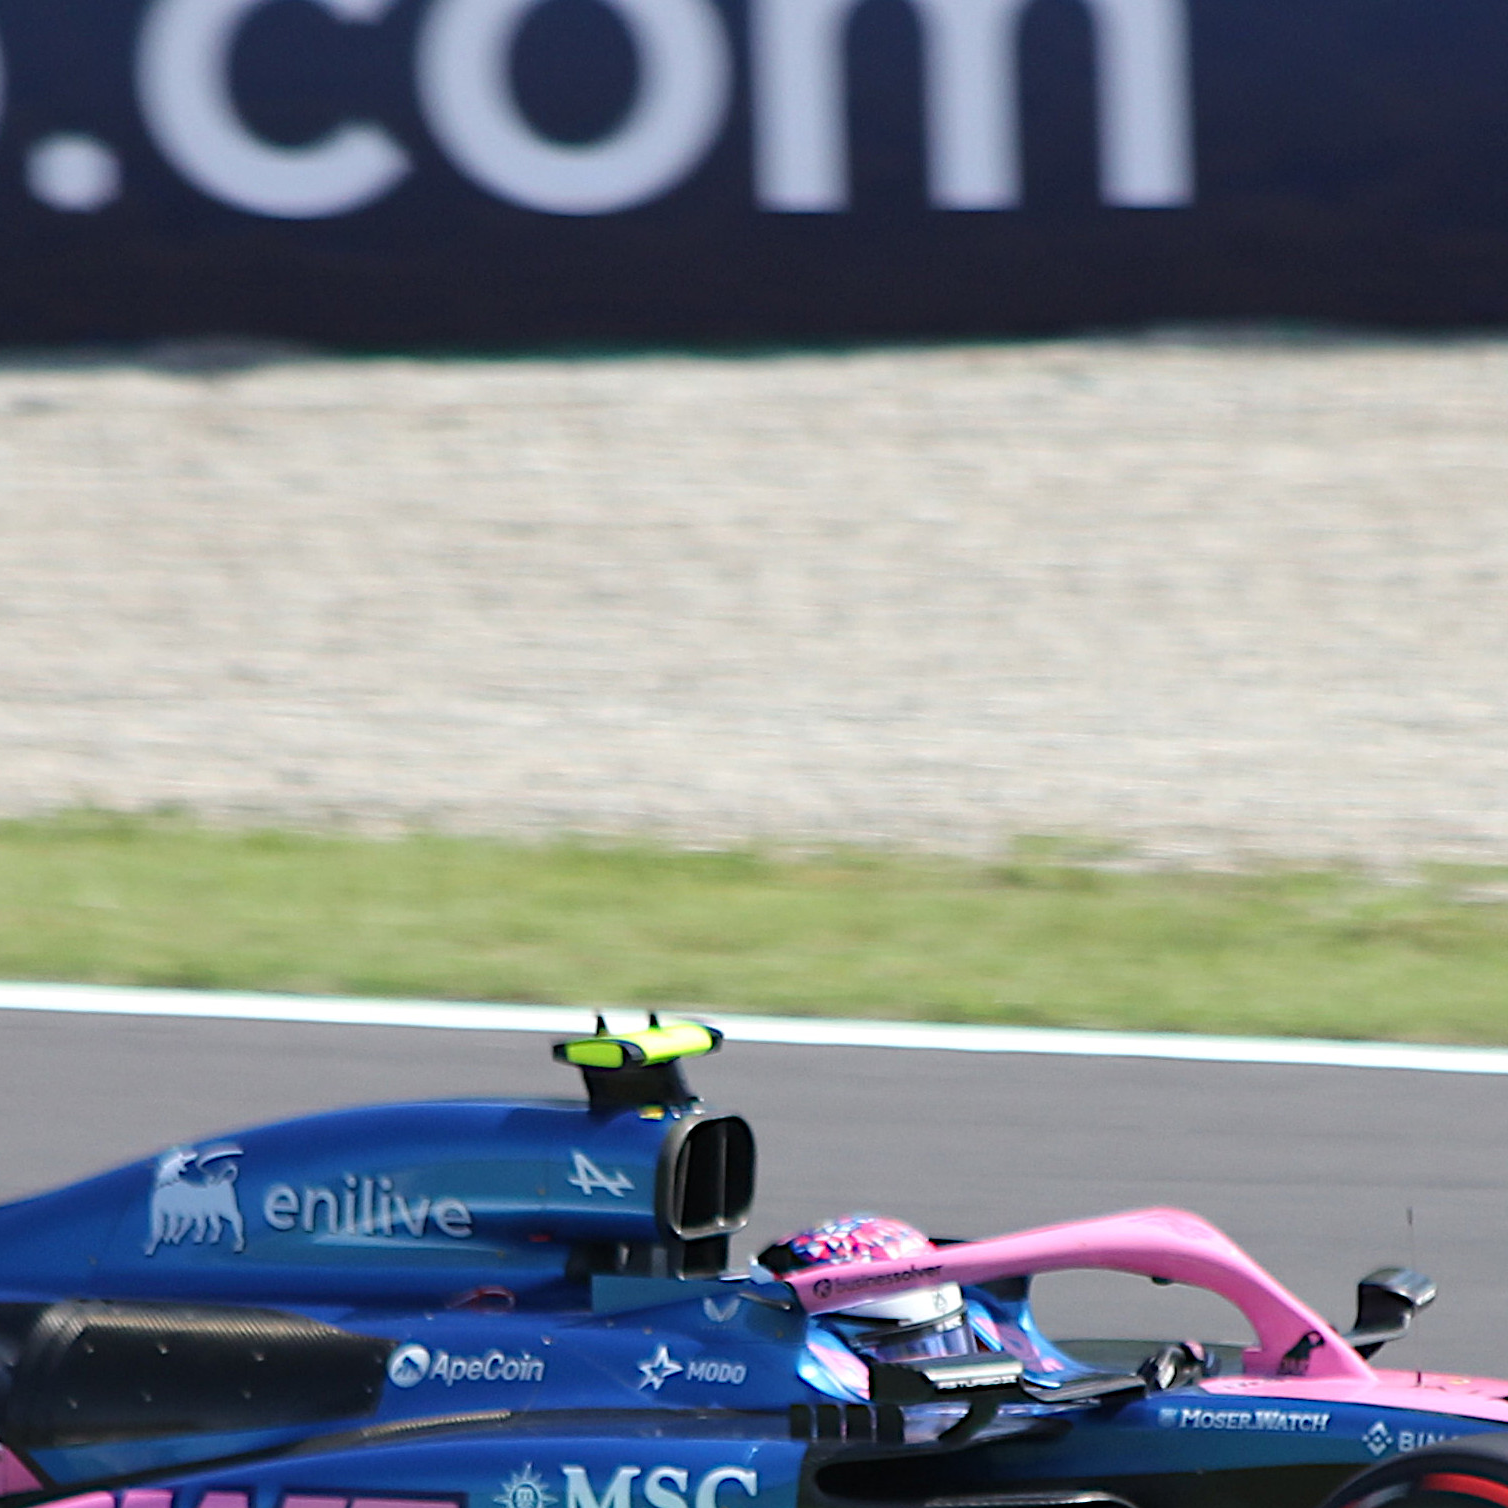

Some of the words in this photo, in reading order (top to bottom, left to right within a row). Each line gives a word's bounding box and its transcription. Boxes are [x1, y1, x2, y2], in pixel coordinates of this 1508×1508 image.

[264, 1174, 473, 1239] enilive
[429, 1351, 544, 1387] ApeCoin
[686, 1359, 746, 1385] MODO
[1398, 1431, 1456, 1452] BIN
